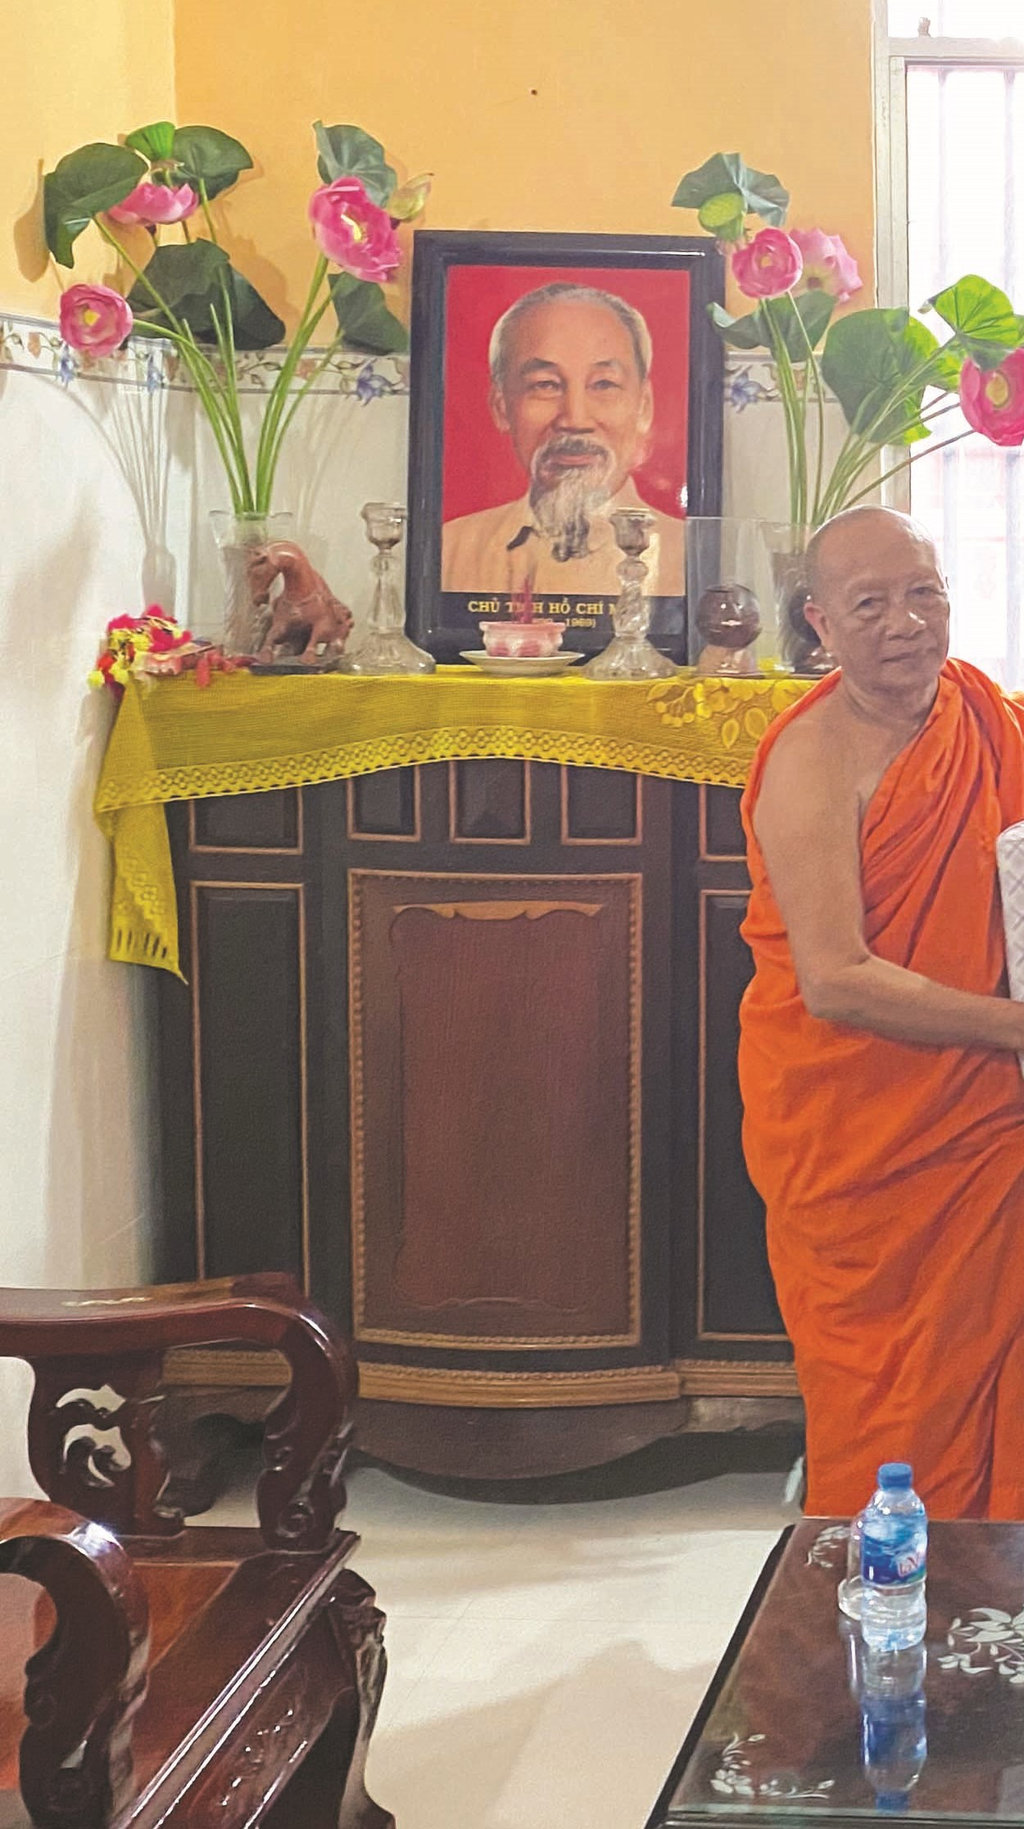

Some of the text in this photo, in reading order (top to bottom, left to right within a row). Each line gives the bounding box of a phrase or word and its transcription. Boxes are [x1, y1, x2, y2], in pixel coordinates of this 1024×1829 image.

[467, 597, 500, 614] CHỦ
[548, 597, 572, 614] HỒ
[575, 600, 604, 615] CHÍ
